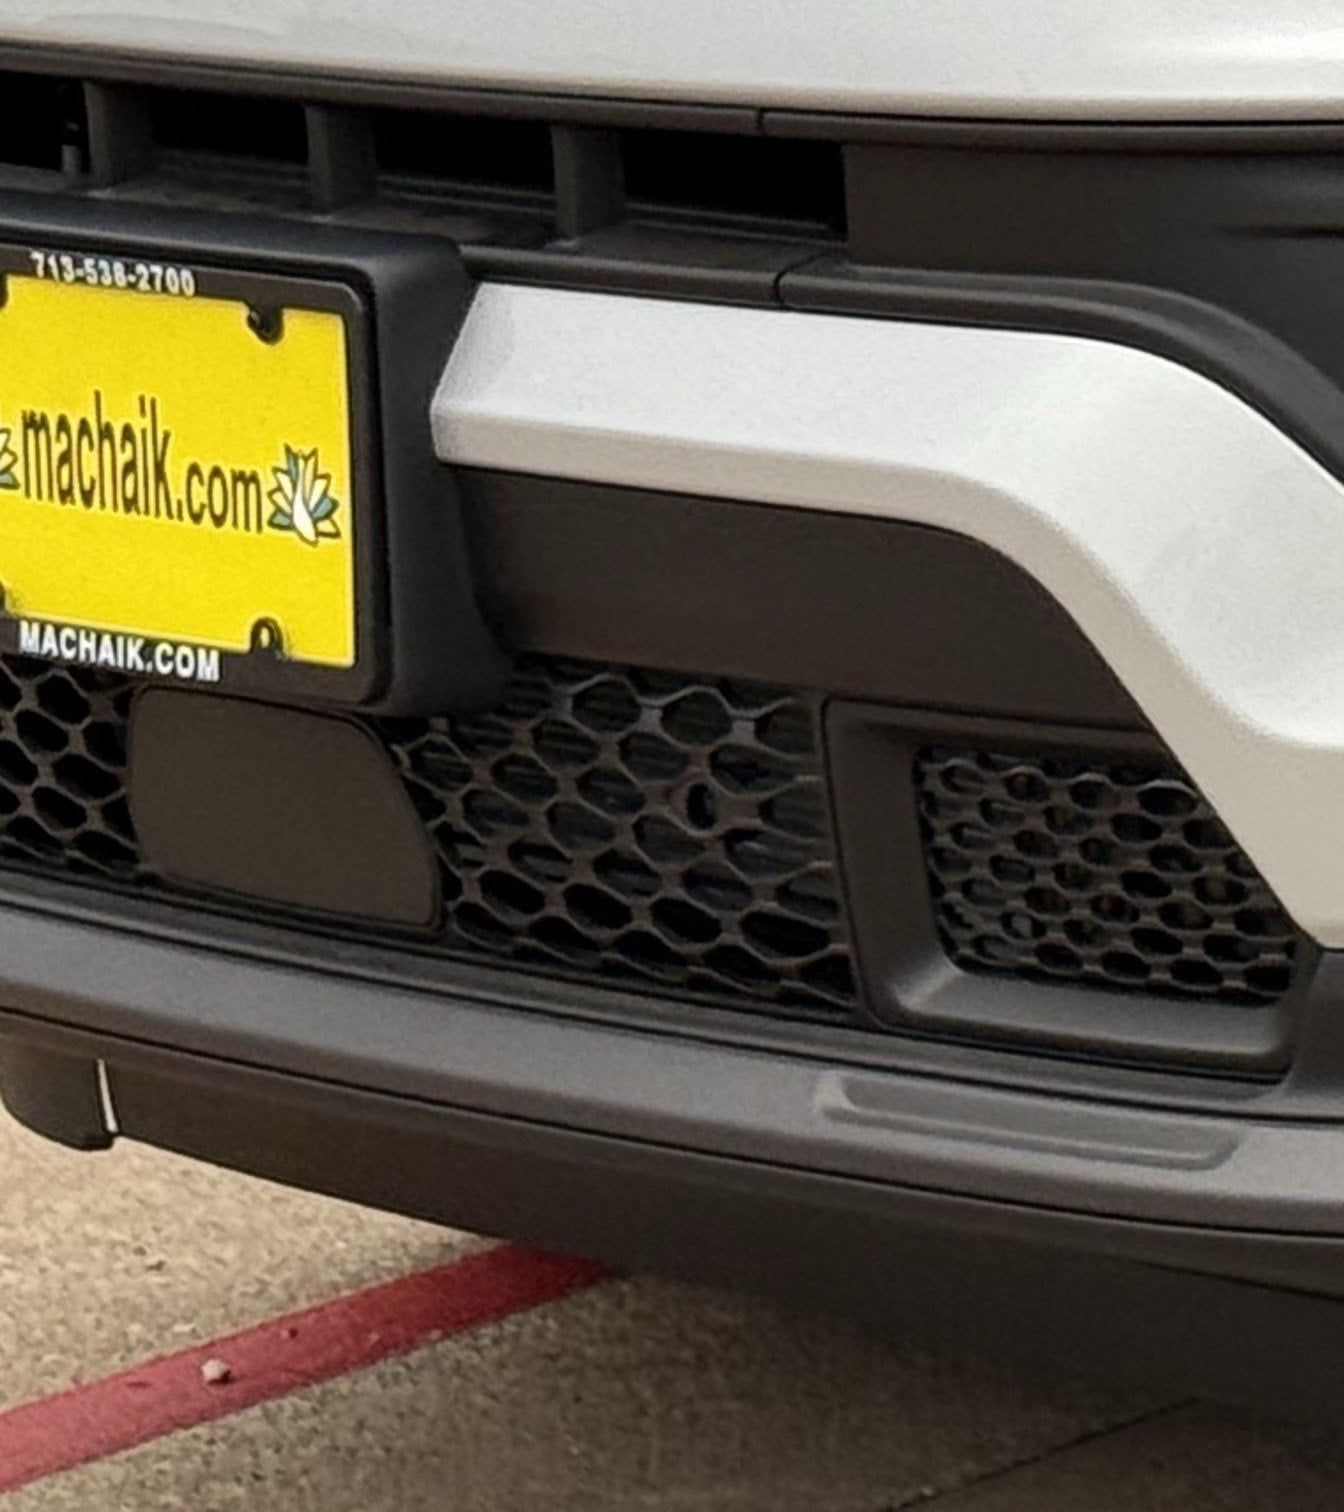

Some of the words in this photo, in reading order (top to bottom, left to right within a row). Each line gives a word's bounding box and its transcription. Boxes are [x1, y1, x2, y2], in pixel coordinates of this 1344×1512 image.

[30, 251, 196, 297] 713-538-2700
[20, 389, 264, 533] machaik.com
[18, 619, 221, 683] MACHAIK.COM
